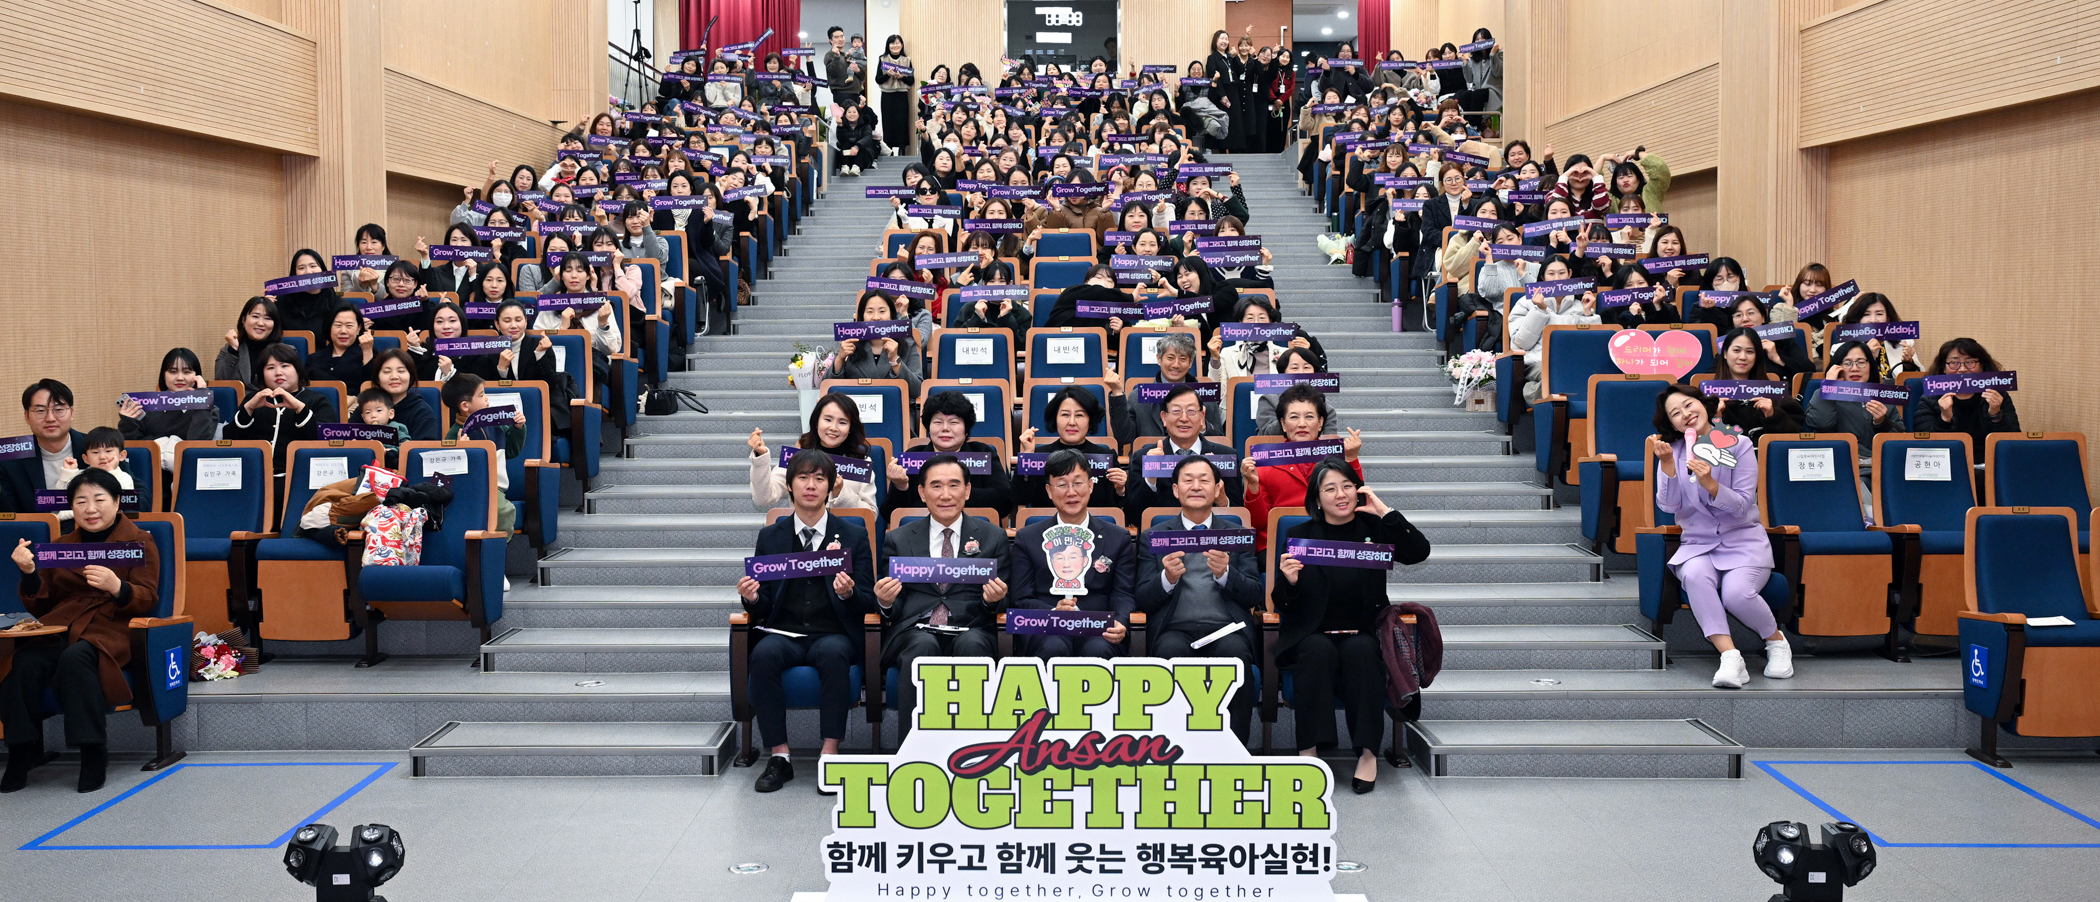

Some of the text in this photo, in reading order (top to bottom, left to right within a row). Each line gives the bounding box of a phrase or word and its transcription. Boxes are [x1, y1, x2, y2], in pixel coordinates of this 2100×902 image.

[696, 106, 718, 117] Together
[739, 187, 765, 197] Together
[1143, 193, 1172, 201] Together
[491, 230, 522, 238] Together
[455, 250, 488, 258] Together
[1114, 258, 1172, 267] Happy Together
[1557, 282, 1594, 292] Together
[1604, 294, 1633, 303] Happy
[1818, 285, 1855, 304] Together
[1147, 300, 1210, 315] Happy Together
[838, 325, 909, 336] Happy Together
[1224, 327, 1294, 336] Happy Together
[1767, 325, 1793, 336] 성장하다
[1841, 326, 1916, 337] Happy Together
[1927, 377, 2013, 390] Happy Together
[1704, 385, 1785, 397] Happy Together
[160, 395, 207, 406] Together
[859, 403, 876, 412] 빈석
[475, 411, 516, 422] Togethe
[323, 429, 394, 439] Grow Together
[835, 461, 869, 475] gether
[1143, 460, 1158, 472] 함께
[1151, 534, 1254, 547] 함께 그리고, 함께 성장하다
[1288, 546, 1392, 562] 함께 그리고, 함께 성장하다
[753, 557, 844, 573] Grow Together
[894, 562, 992, 577] Happy Together
[1014, 615, 1107, 630] Grow Together
[918, 664, 1237, 731] HAPPY
[947, 707, 1183, 779] Ansan
[823, 762, 1330, 830] TOGETHER
[827, 842, 1330, 875] 함께 키우고 함께 웃는 행복육아실현!
[878, 883, 1275, 900] Happy together, Grow together
